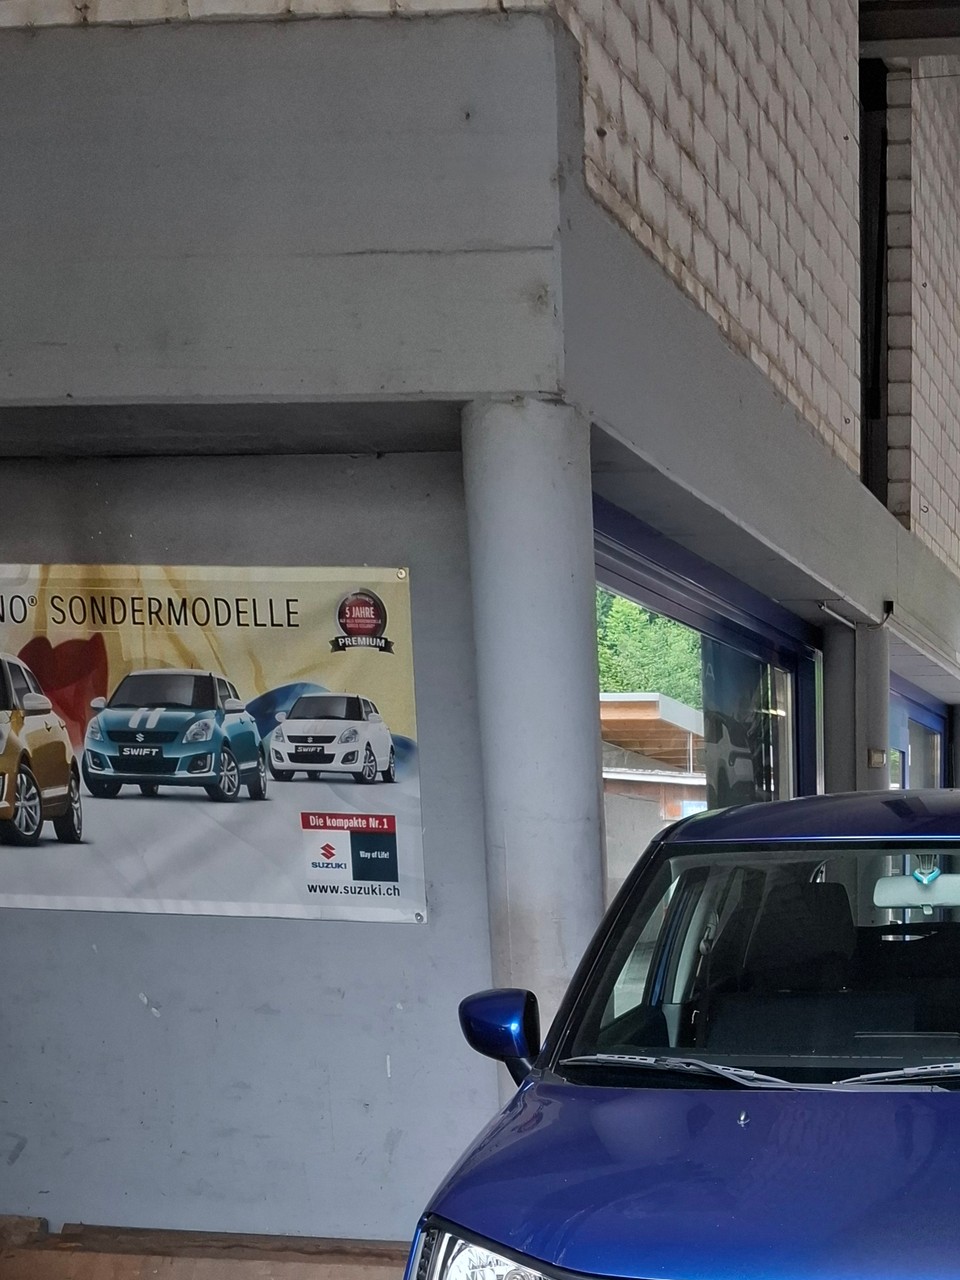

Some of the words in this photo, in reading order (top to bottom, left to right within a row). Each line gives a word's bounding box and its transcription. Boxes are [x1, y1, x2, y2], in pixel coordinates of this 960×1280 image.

[50, 595, 300, 628] SONDERMODELLE
[345, 606, 350, 618] 5
[351, 606, 375, 618] JAHRE
[338, 636, 386, 648] PREMIUM
[122, 747, 160, 757] SWIFT
[309, 815, 324, 826] Die
[326, 816, 367, 829] kompakte
[360, 851, 371, 859] Way
[307, 884, 400, 896] www.suzuki.ch
